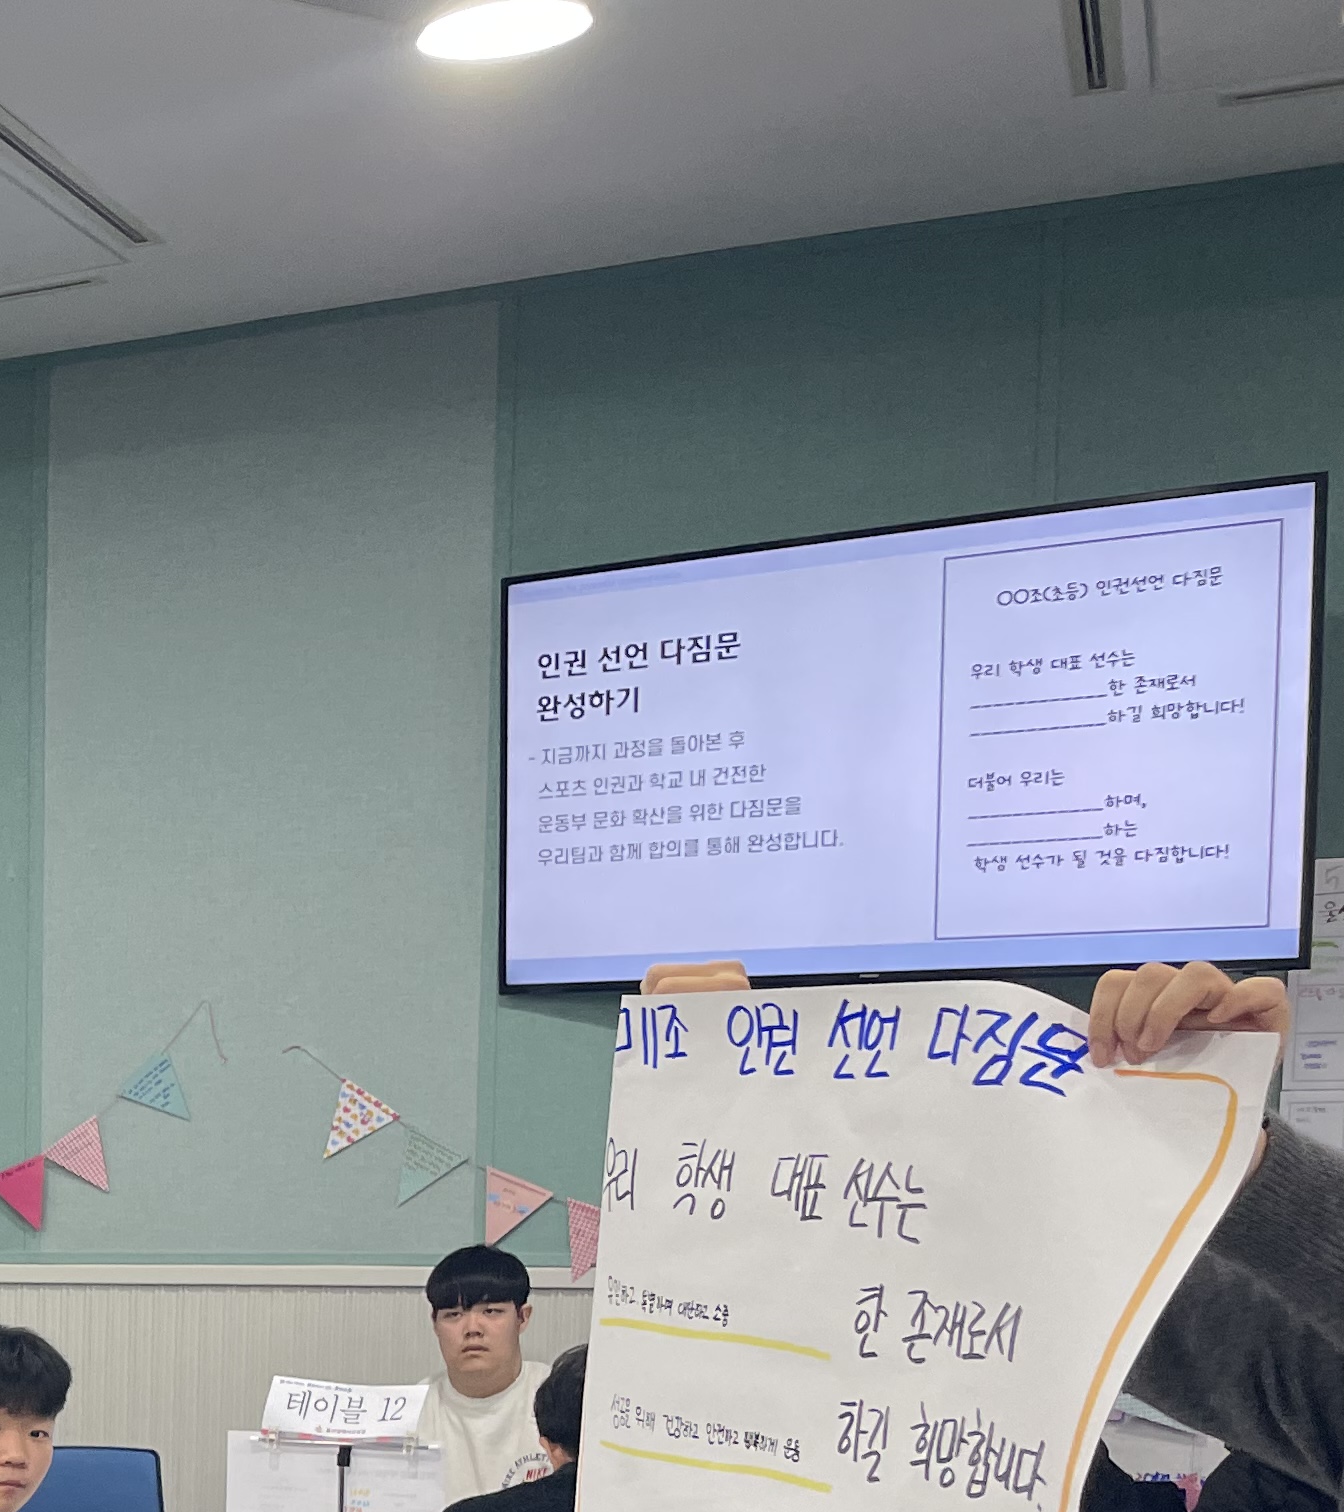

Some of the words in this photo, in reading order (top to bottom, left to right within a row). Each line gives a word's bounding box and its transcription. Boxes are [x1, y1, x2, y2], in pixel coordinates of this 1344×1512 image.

[1096, 572, 1165, 597] 인권선언
[1172, 565, 1224, 587] 다짐문
[538, 649, 588, 680] 인권
[598, 642, 648, 673] 선언
[660, 631, 741, 666] 다짐문
[970, 662, 1001, 679] 우리
[1009, 656, 1044, 677] 학생
[1051, 653, 1082, 671] 대표
[1089, 649, 1136, 670] 선수는
[536, 686, 641, 723] 완성하기
[1107, 678, 1127, 698] 한
[1133, 674, 1197, 695] 존재로서
[1107, 705, 1144, 724] 하길
[1151, 697, 1247, 721] 희망합니다!
[540, 744, 607, 766] 지금까지
[614, 737, 664, 760] 과정을
[670, 732, 722, 756] 돌아본
[728, 730, 746, 750] 후
[537, 778, 588, 800] 스포츠
[593, 774, 644, 796] 인권과
[649, 770, 684, 792] 학교
[689, 768, 707, 788] 내
[712, 763, 768, 785] 건전한
[967, 771, 1013, 792] 더불어
[1019, 768, 1066, 788] 우리는
[537, 813, 588, 835] 운동부
[593, 809, 627, 830] 문화
[632, 804, 683, 826] 확산을
[689, 800, 724, 822] 위한
[729, 795, 803, 820] 다짐문을
[1103, 792, 1148, 810] 하며,
[537, 844, 604, 866] 우리팀과
[608, 841, 643, 862] 함께
[648, 837, 700, 859] 합의를
[706, 834, 741, 856] 통해
[746, 828, 845, 852] 완성합니다.
[1103, 819, 1138, 838] 하는
[974, 853, 1008, 874] 학생
[1014, 850, 1065, 870] 선수가
[1071, 848, 1087, 870] 될
[1095, 846, 1127, 868] 것을
[1133, 842, 1231, 866] 다짐합니다!
[726, 1002, 798, 1077] 인권
[827, 997, 903, 1080] 선언
[602, 1136, 638, 1213] 우리
[672, 1137, 737, 1220] 학생
[769, 1152, 830, 1222] 대표
[843, 1157, 929, 1245] 선수는
[853, 1282, 889, 1359] 한
[900, 1289, 1024, 1365] 존재로서
[286, 1388, 368, 1426] 테이블
[377, 1396, 408, 1423] 12
[836, 1398, 891, 1484] 하길
